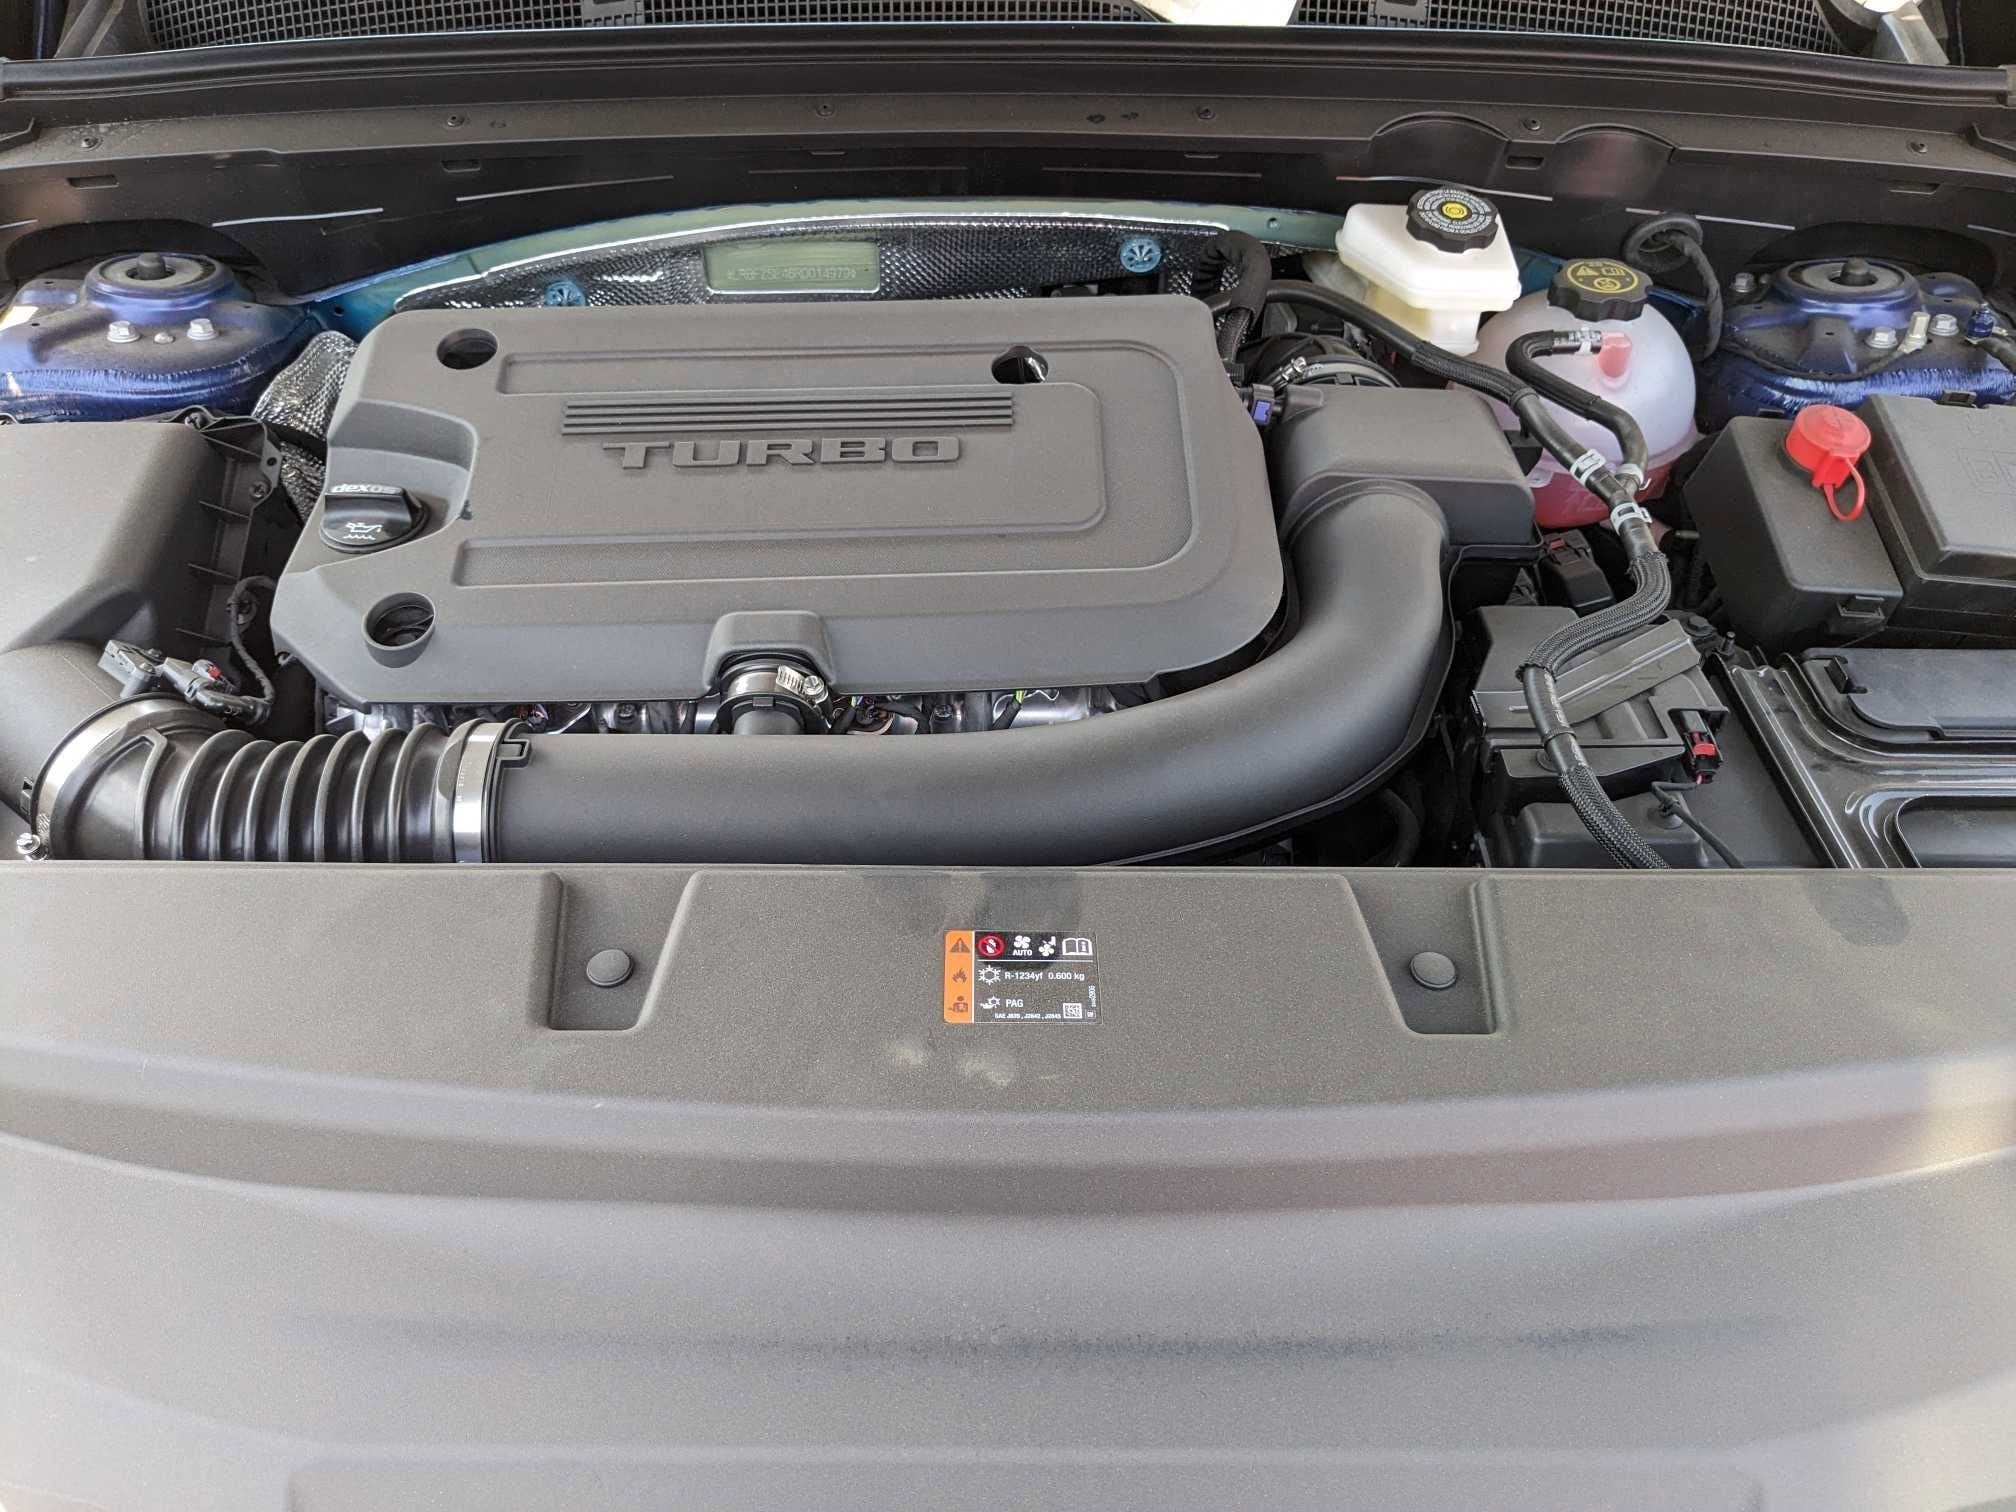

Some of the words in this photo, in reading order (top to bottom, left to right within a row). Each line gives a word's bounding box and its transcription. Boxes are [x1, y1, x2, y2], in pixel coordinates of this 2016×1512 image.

[602, 436, 959, 469] TURBO
[331, 484, 401, 494] dexos
[1004, 972, 1043, 982] R-1234yf
[1048, 972, 1072, 980] 0.600
[1074, 972, 1085, 982] kg
[1005, 998, 1024, 1007] PAG
